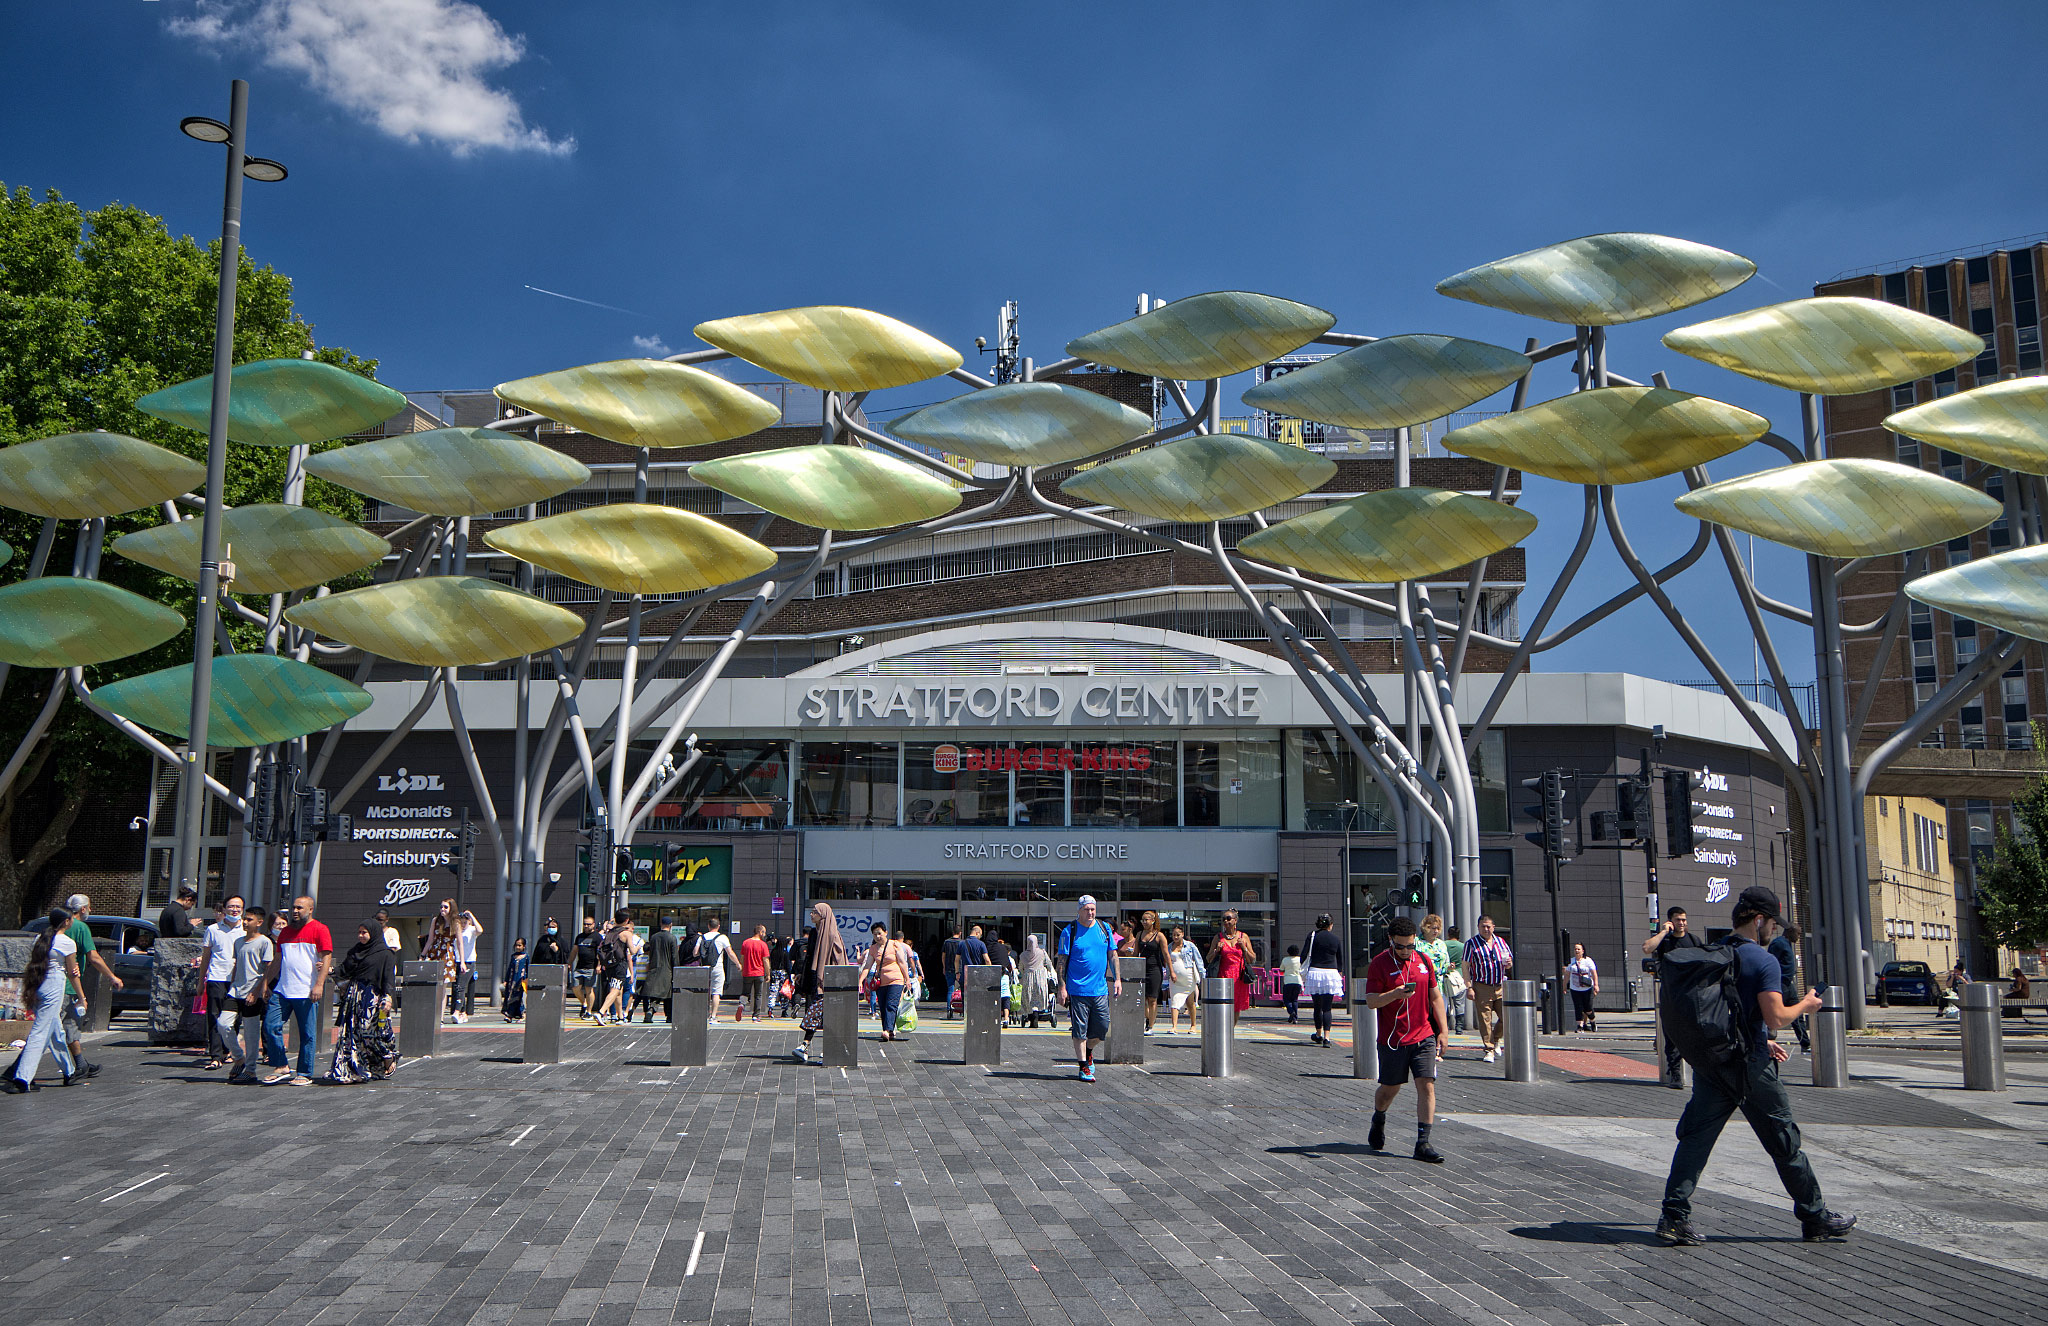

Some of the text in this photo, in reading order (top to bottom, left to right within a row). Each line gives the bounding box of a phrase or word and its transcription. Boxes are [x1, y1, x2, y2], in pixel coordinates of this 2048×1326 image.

[805, 681, 1261, 719] STRATFORD CENTRE
[935, 759, 959, 767] KING
[966, 748, 1151, 771] BURGER KING
[366, 805, 453, 818] McDonald's
[353, 828, 459, 840] SPORTSDIRECT.c
[363, 849, 450, 868] Sainsbury's
[944, 843, 1128, 859] STRATFORD CENTRE
[1693, 847, 1737, 868] Sainsbury's
[379, 878, 430, 905] Boots
[1705, 876, 1730, 903] Boots
